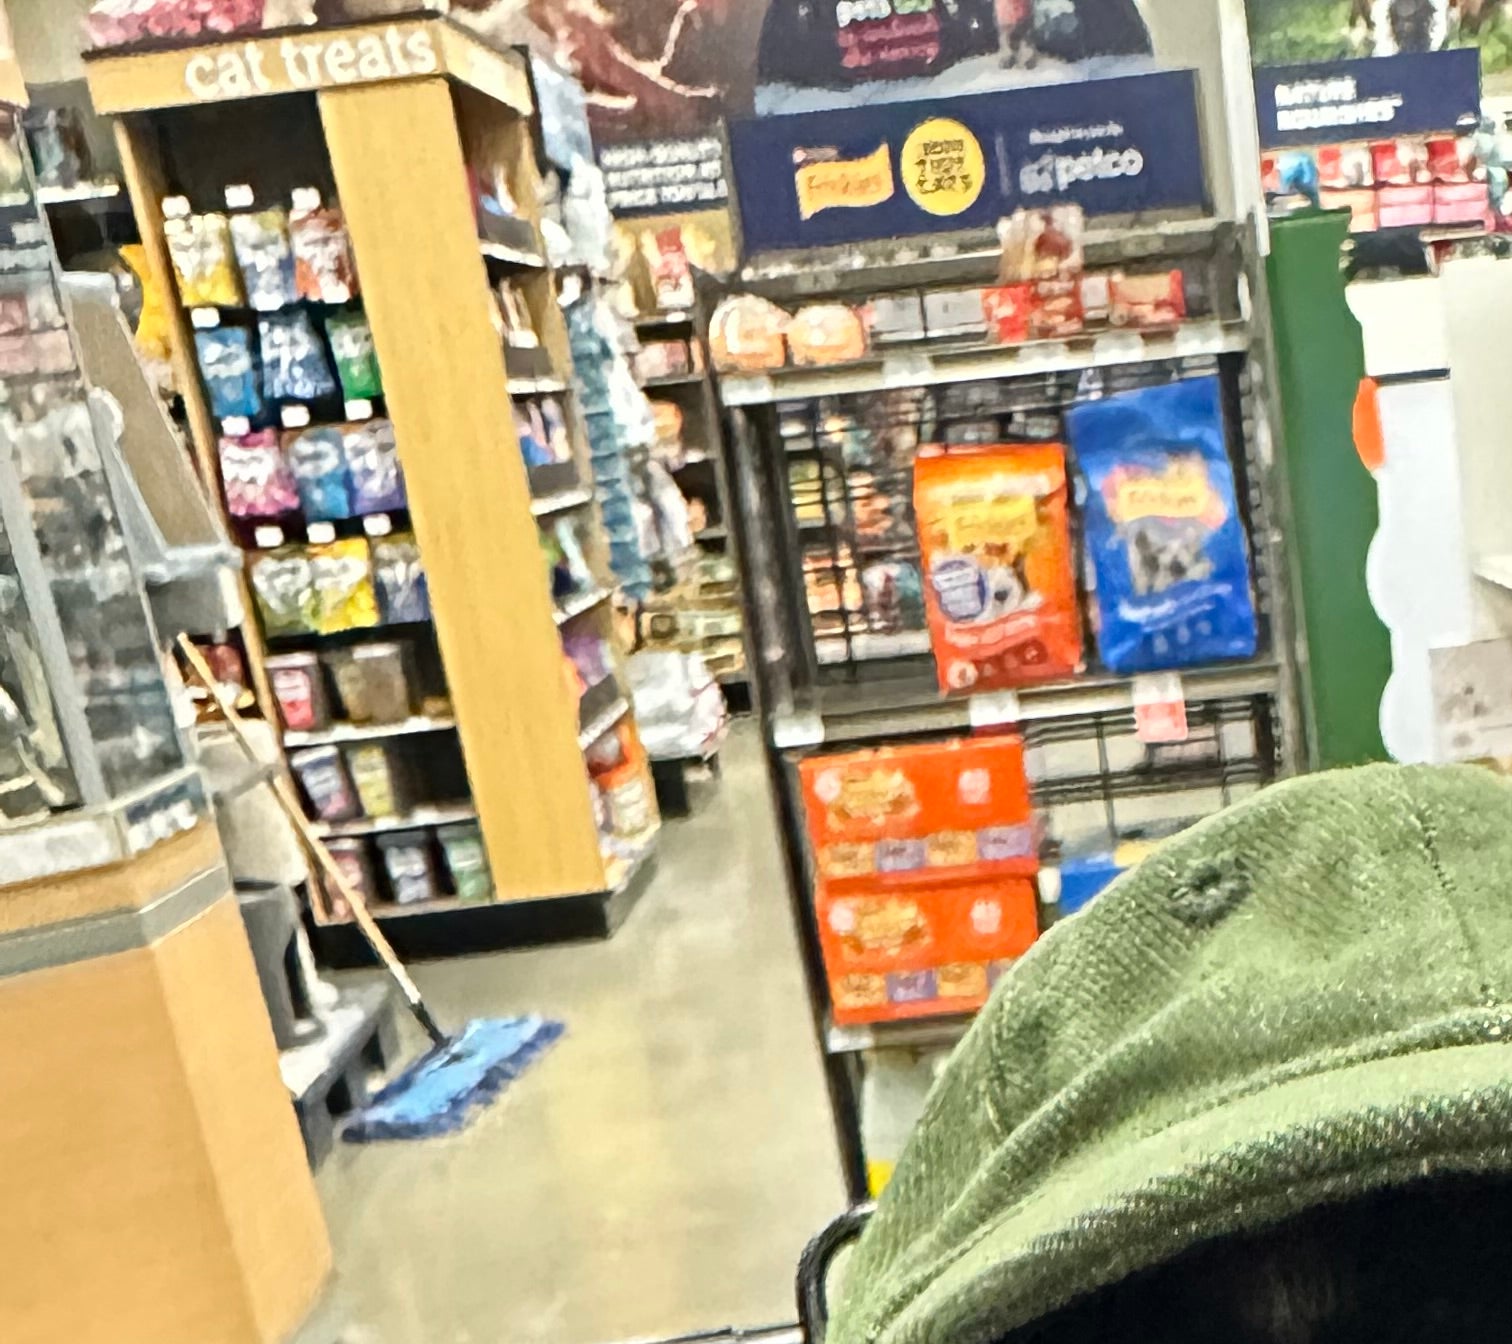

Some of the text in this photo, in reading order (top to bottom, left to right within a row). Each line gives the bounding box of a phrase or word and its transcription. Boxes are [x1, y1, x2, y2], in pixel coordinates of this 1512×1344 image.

[184, 24, 437, 100] cat treats
[1055, 146, 1144, 191] petco
